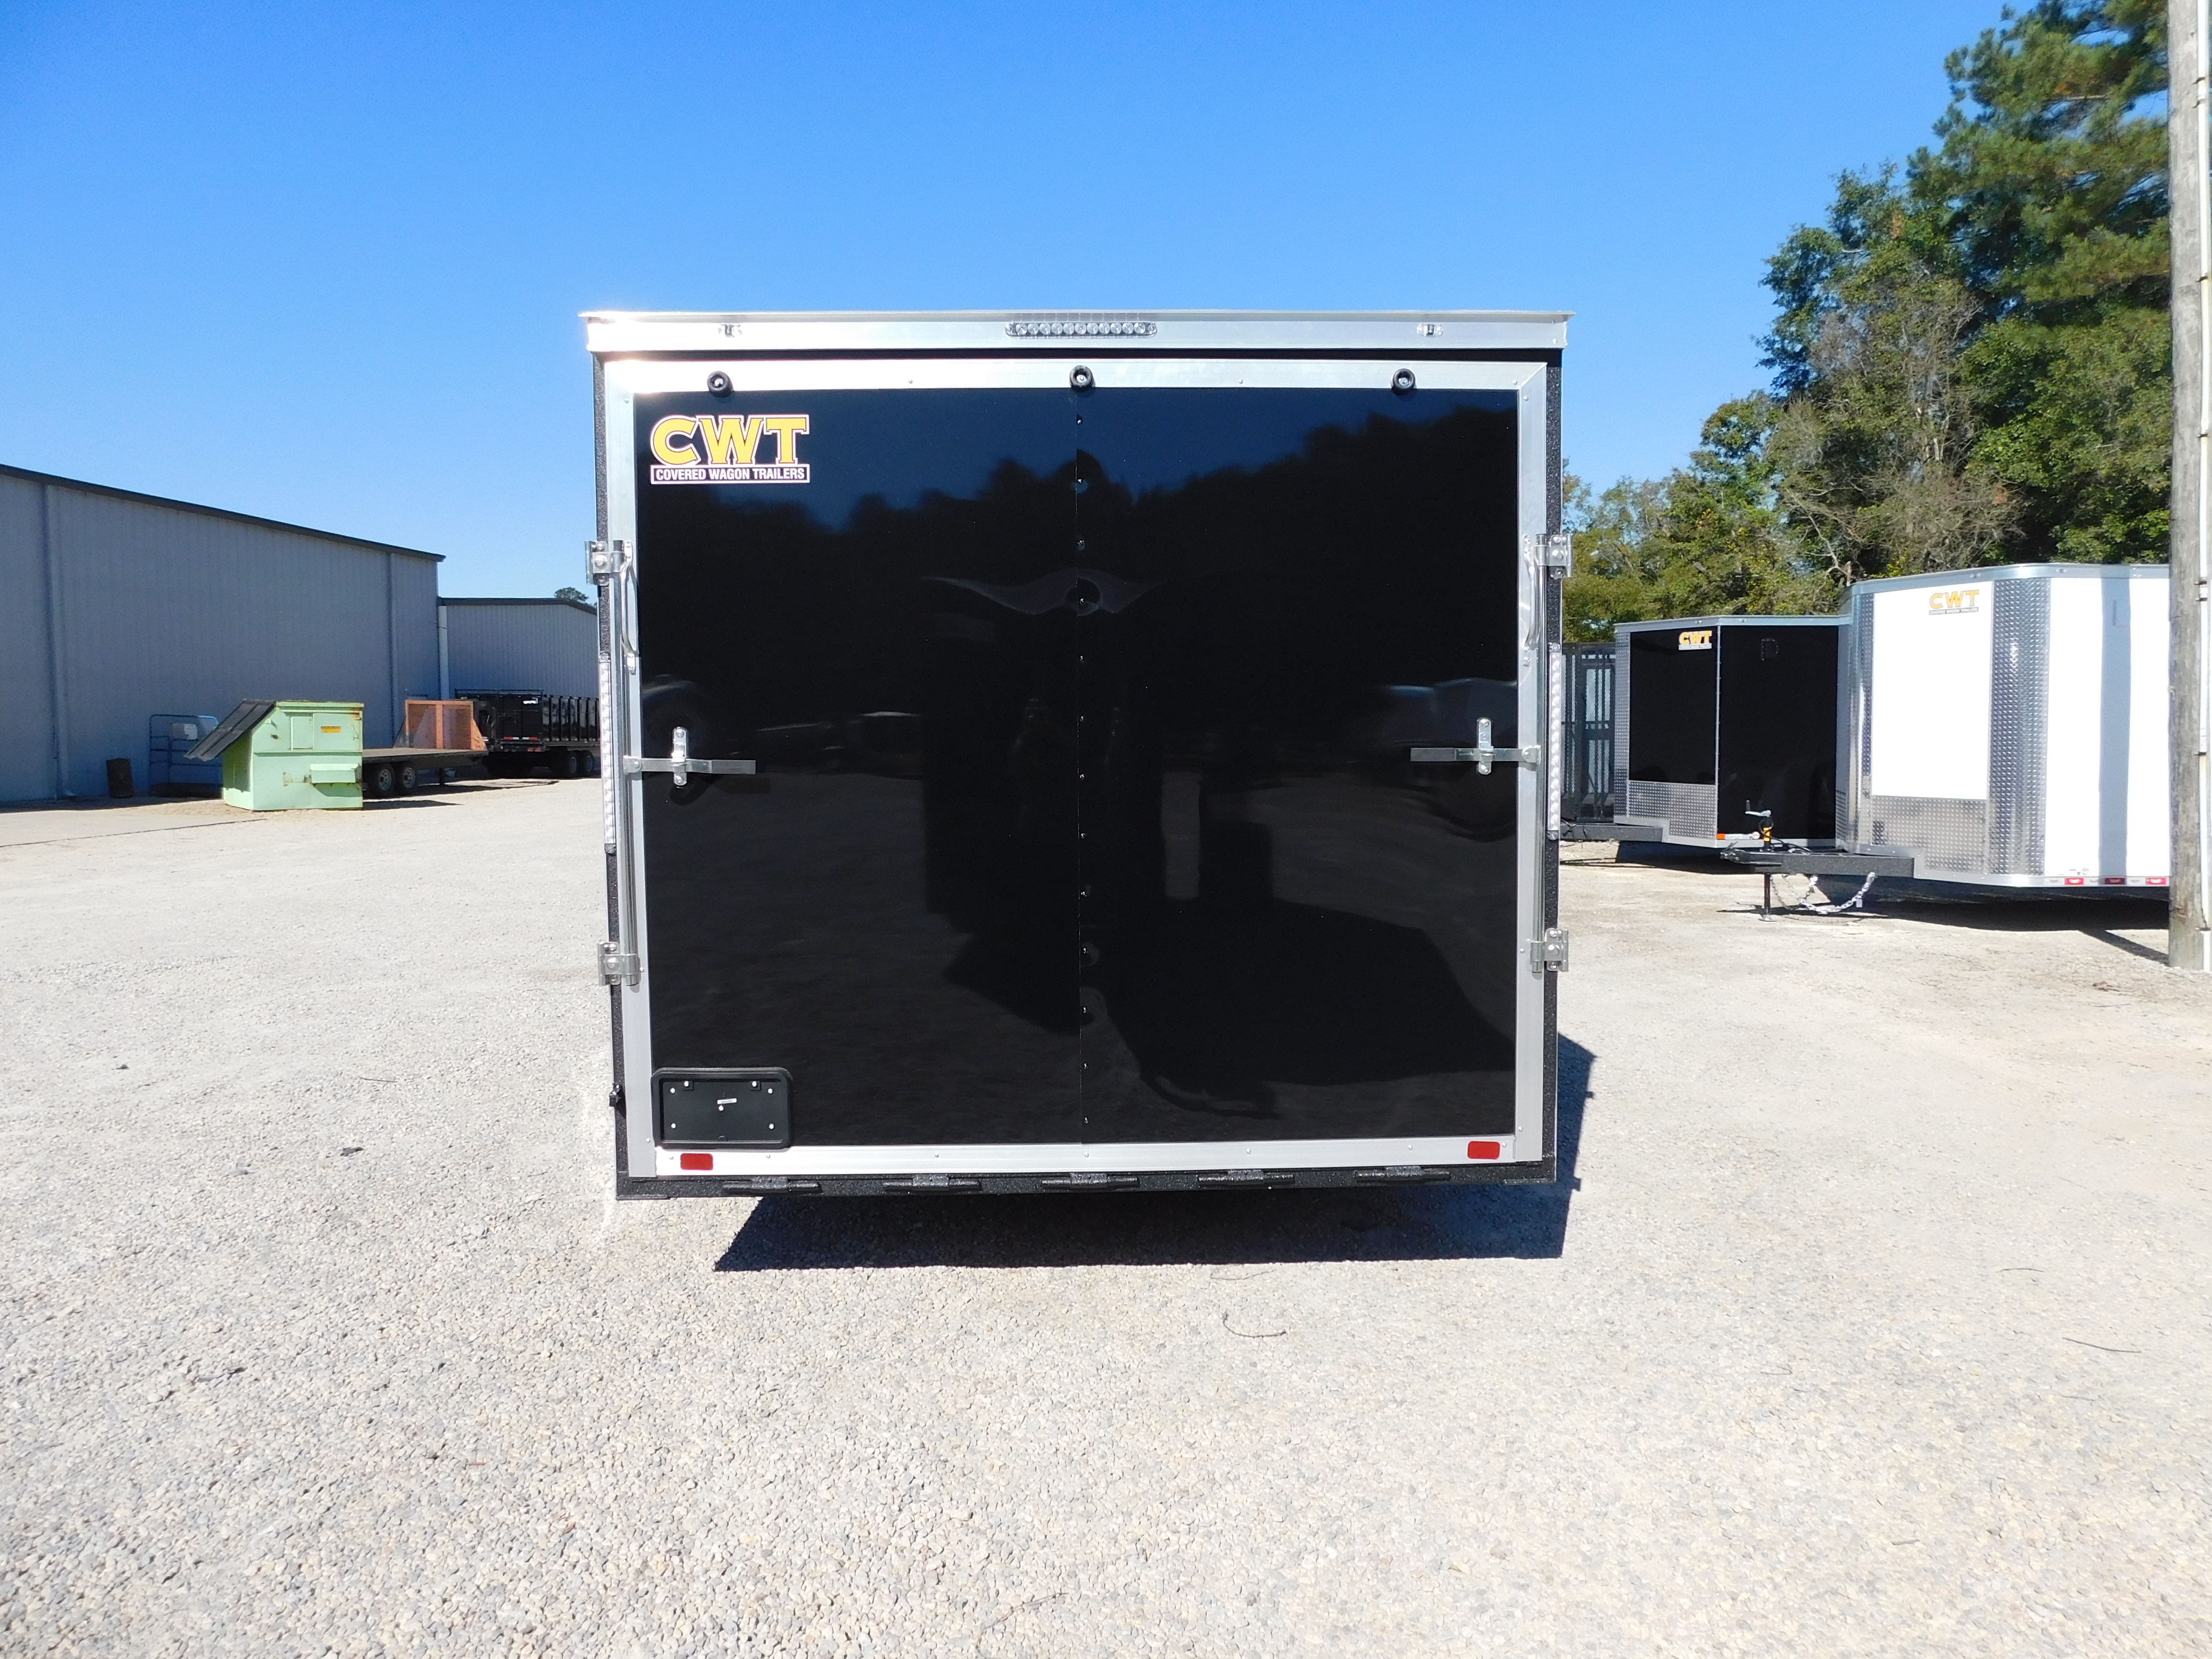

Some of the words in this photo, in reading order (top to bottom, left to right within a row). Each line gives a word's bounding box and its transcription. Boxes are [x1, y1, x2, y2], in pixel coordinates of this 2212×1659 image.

[651, 415, 808, 466] CWT
[656, 469, 706, 481] COVERED
[709, 468, 750, 480] WAGON
[752, 468, 805, 480] TRAILERS
[1929, 589, 1979, 609] CWT
[1679, 631, 1712, 645] CWT
